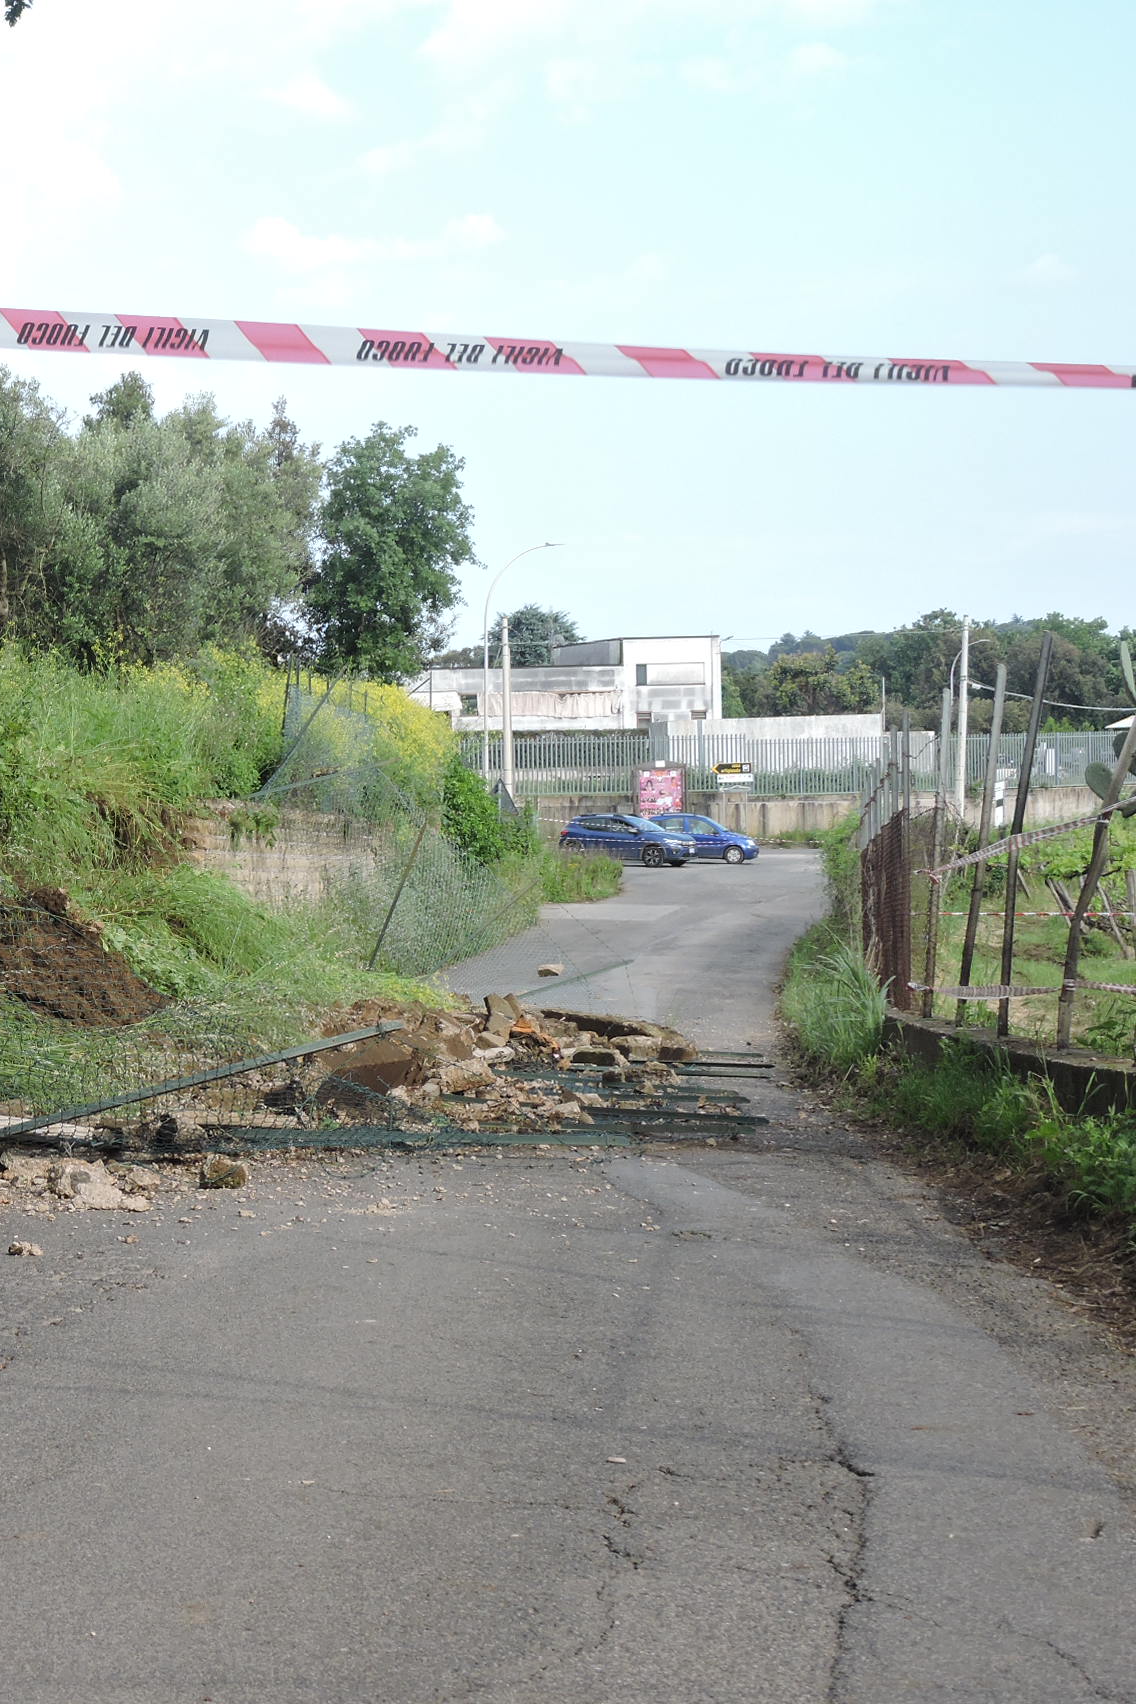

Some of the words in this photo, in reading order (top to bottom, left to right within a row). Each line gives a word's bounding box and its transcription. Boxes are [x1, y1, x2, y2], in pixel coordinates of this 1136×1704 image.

[16, 322, 91, 346] FUOCO
[97, 324, 137, 348] DEL
[141, 326, 210, 351] VIGILI
[355, 339, 435, 363] FUOCO
[444, 343, 485, 364] DEL
[491, 345, 564, 366] VIGILI
[725, 358, 809, 378] FUOCO
[873, 363, 951, 382] VIGILI
